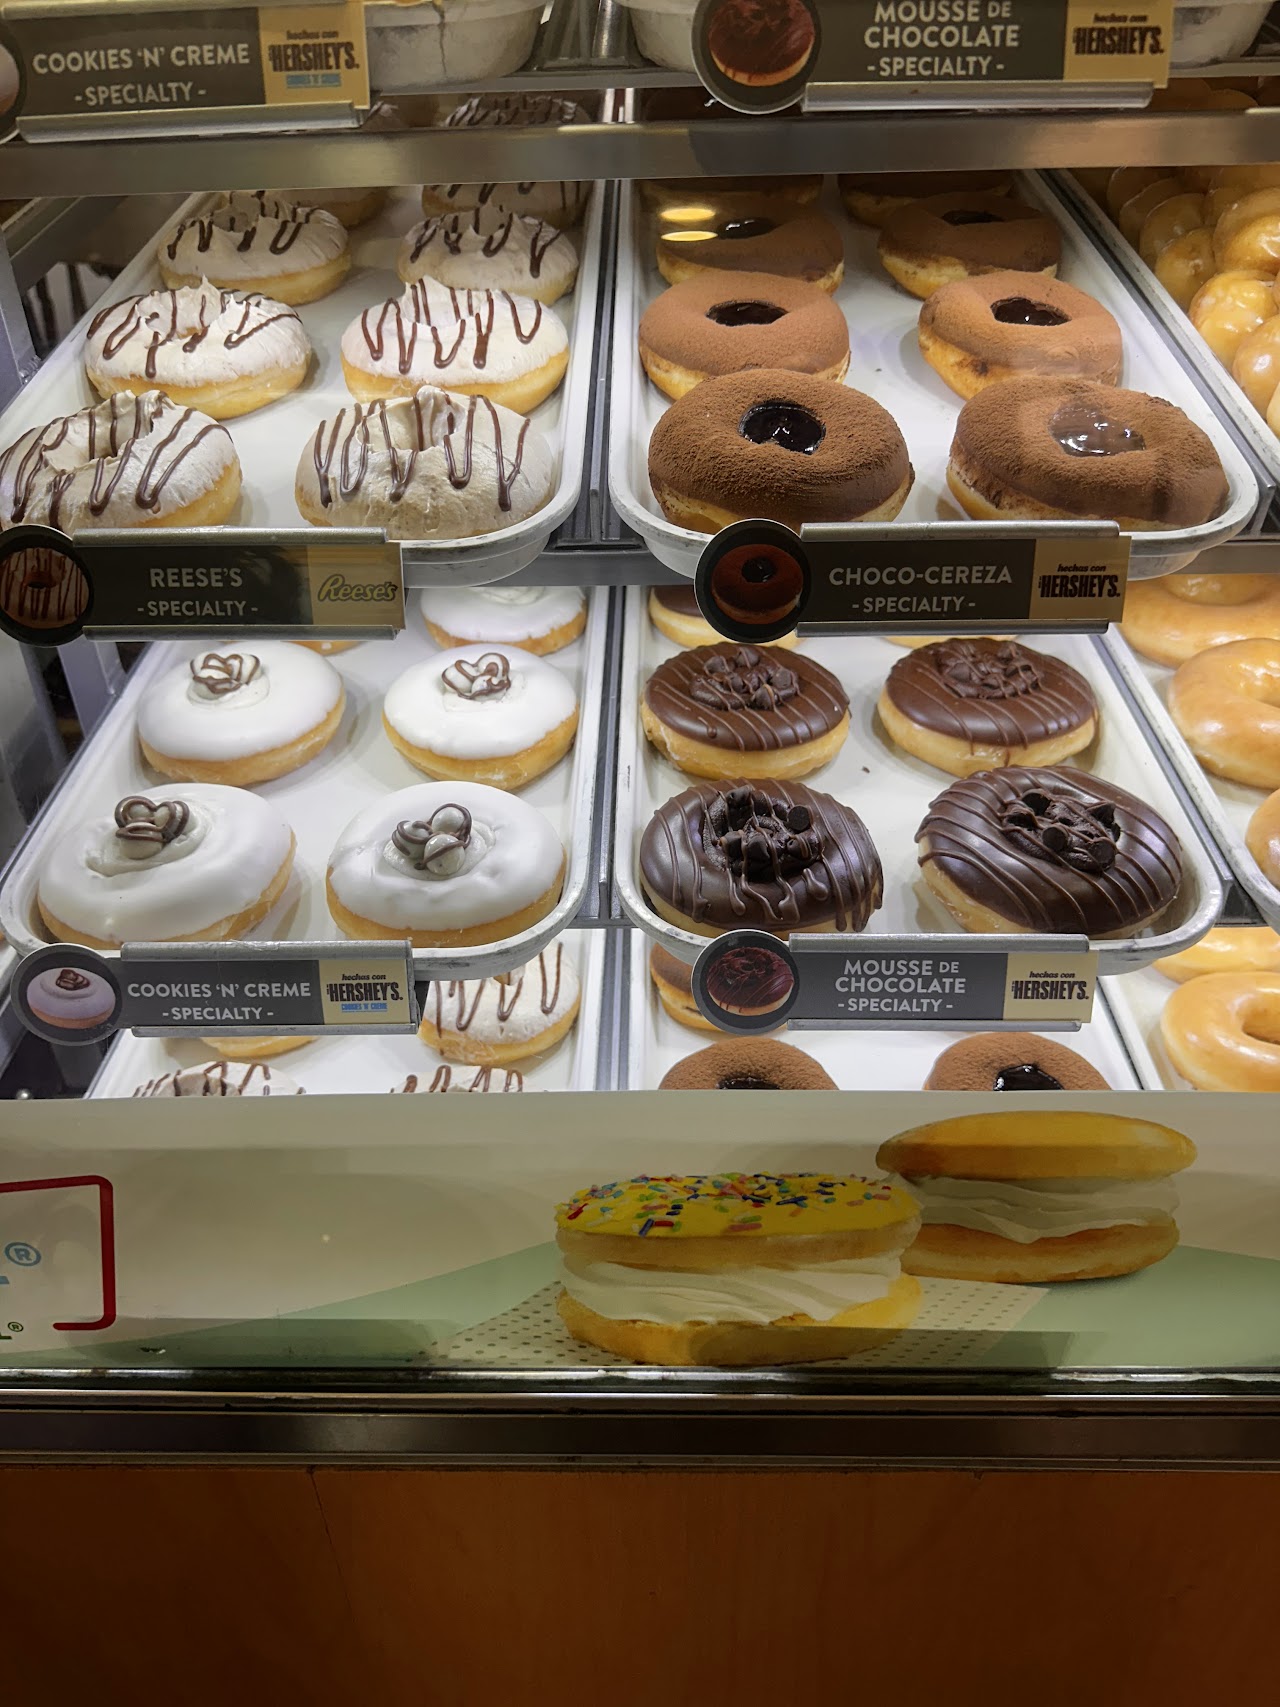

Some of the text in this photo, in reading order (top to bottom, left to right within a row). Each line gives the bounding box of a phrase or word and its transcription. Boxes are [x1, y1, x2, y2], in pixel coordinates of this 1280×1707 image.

[874, 0, 1012, 24] MOUSSE DE
[863, 24, 1020, 49] CHOCOLATE
[32, 47, 133, 74] COOKIES
[170, 43, 250, 67] CREME
[149, 567, 243, 588] REESE'S
[828, 565, 1013, 586] CHOCO-CEREZA
[316, 573, 399, 602] Reese's
[843, 959, 960, 976] MOUSSE DE
[127, 983, 212, 998] COOKIES
[243, 982, 312, 998] CREME
[835, 976, 967, 994] CHOCOLATE
